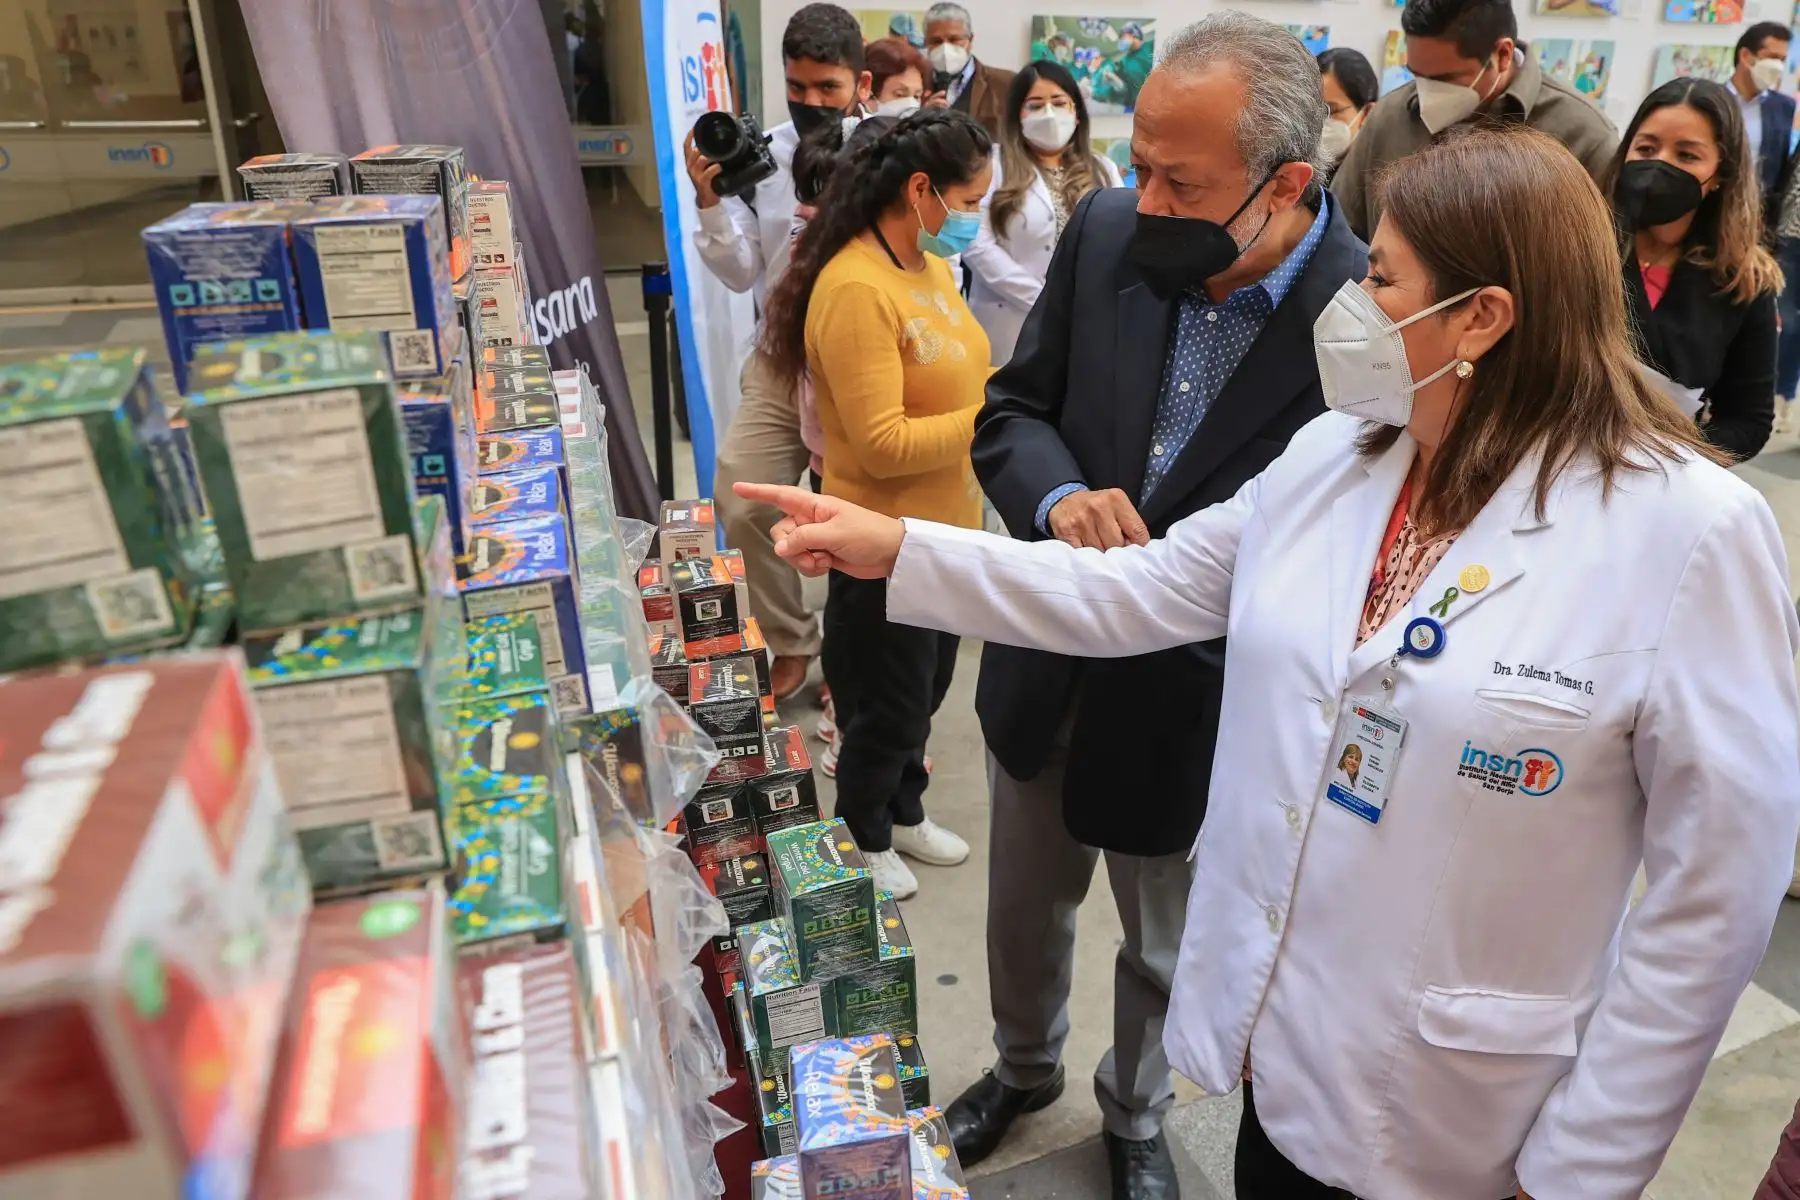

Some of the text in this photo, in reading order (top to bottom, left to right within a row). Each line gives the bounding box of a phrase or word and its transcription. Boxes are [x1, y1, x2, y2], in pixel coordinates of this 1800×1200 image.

[1493, 661, 1595, 696] Dra. Zulema Tomas G.
[1458, 763, 1519, 783] Instituto Nacional
[1460, 740, 1523, 777] insn
[1468, 771, 1487, 782] Salud
[1488, 776, 1500, 785] del
[1482, 782, 1514, 796] San Borja
[780, 853, 796, 872] Gripal
[823, 833, 844, 866] Wawasana
[799, 860, 812, 876] Cold
[776, 1074, 789, 1105] Wawas
[803, 1071, 824, 1119] Relax
[916, 1129, 936, 1184] Wawasana
